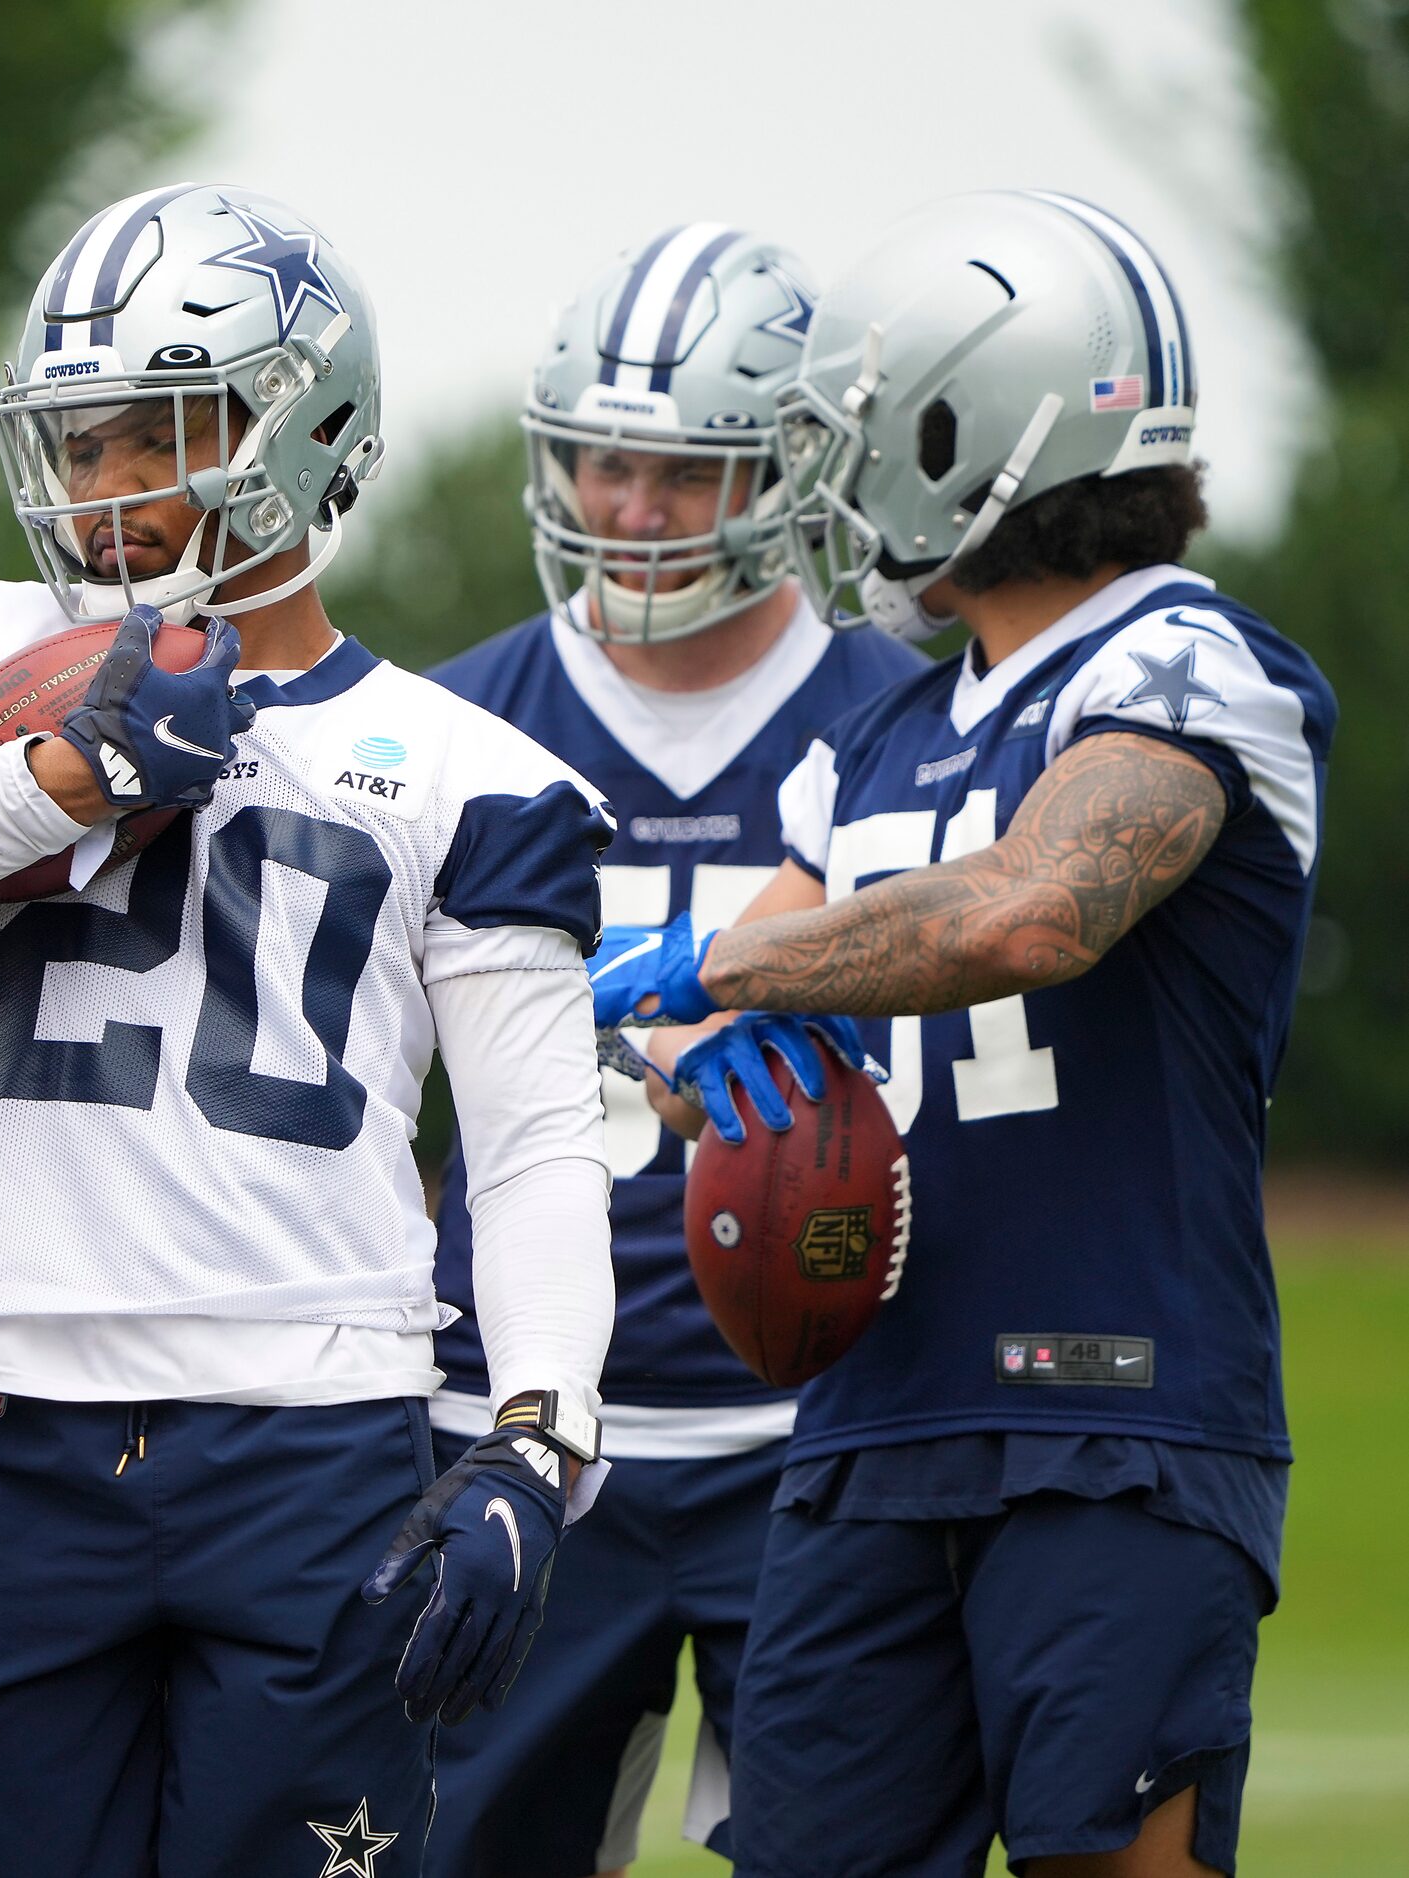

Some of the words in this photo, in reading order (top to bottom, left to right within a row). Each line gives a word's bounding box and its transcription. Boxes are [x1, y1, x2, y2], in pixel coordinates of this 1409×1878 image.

[45, 360, 100, 379] COWBOYS
[40, 650, 109, 691] NATIONAL
[334, 770, 406, 800] AT&T
[806, 1218, 845, 1273] NFL
